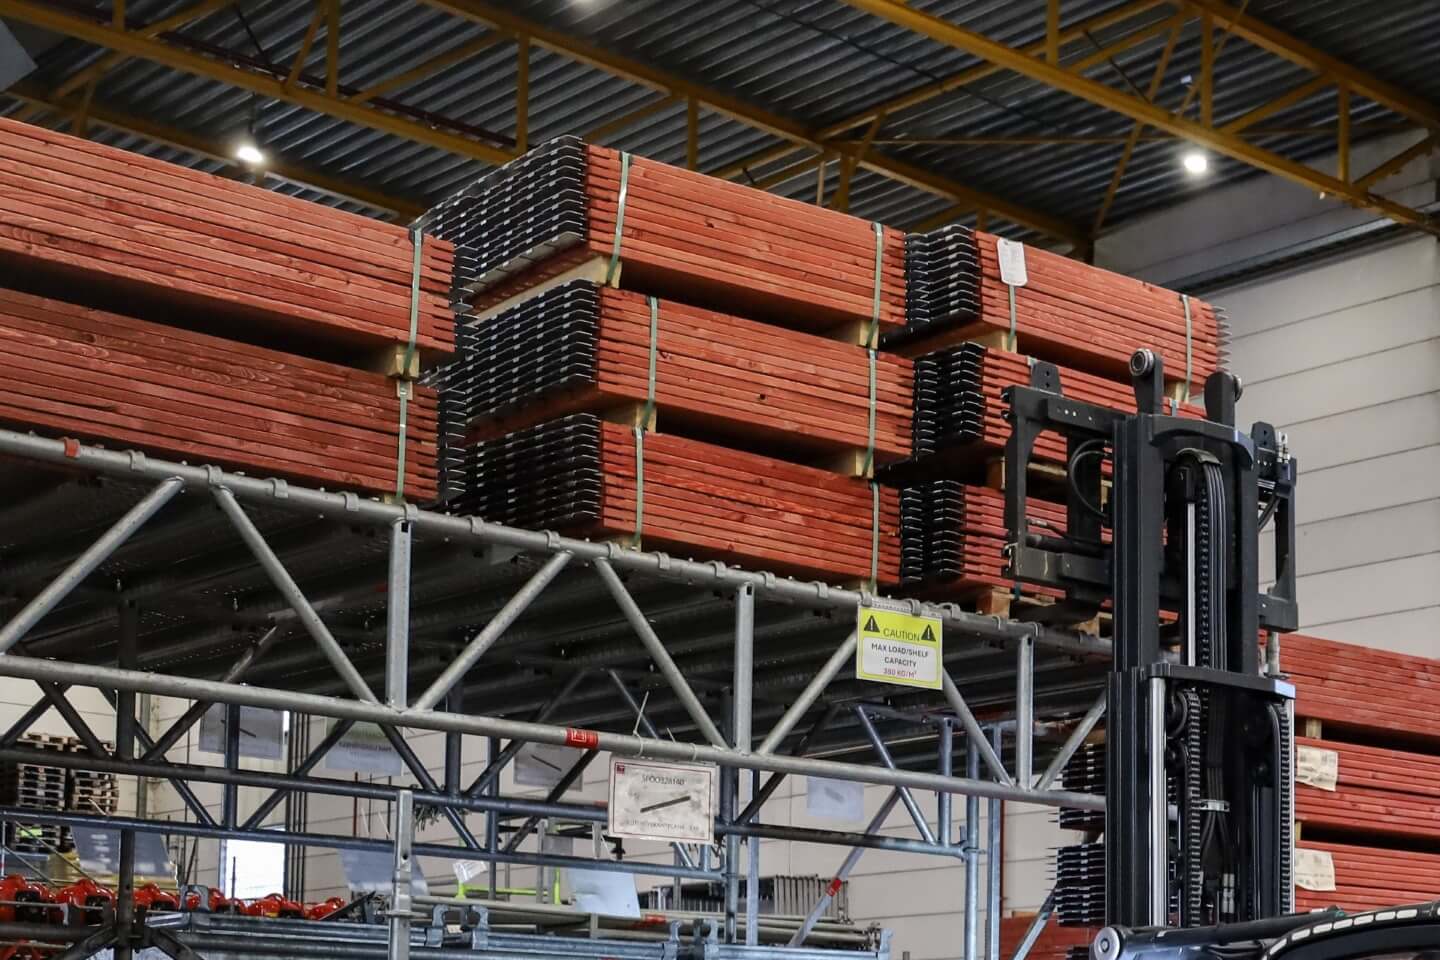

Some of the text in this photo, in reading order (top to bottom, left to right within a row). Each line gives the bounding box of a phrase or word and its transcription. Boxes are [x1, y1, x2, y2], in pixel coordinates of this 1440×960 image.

[883, 628, 920, 642] CAUTION
[871, 643, 928, 658] MAX LOAD/SHELF
[884, 657, 917, 668] CAPACITY
